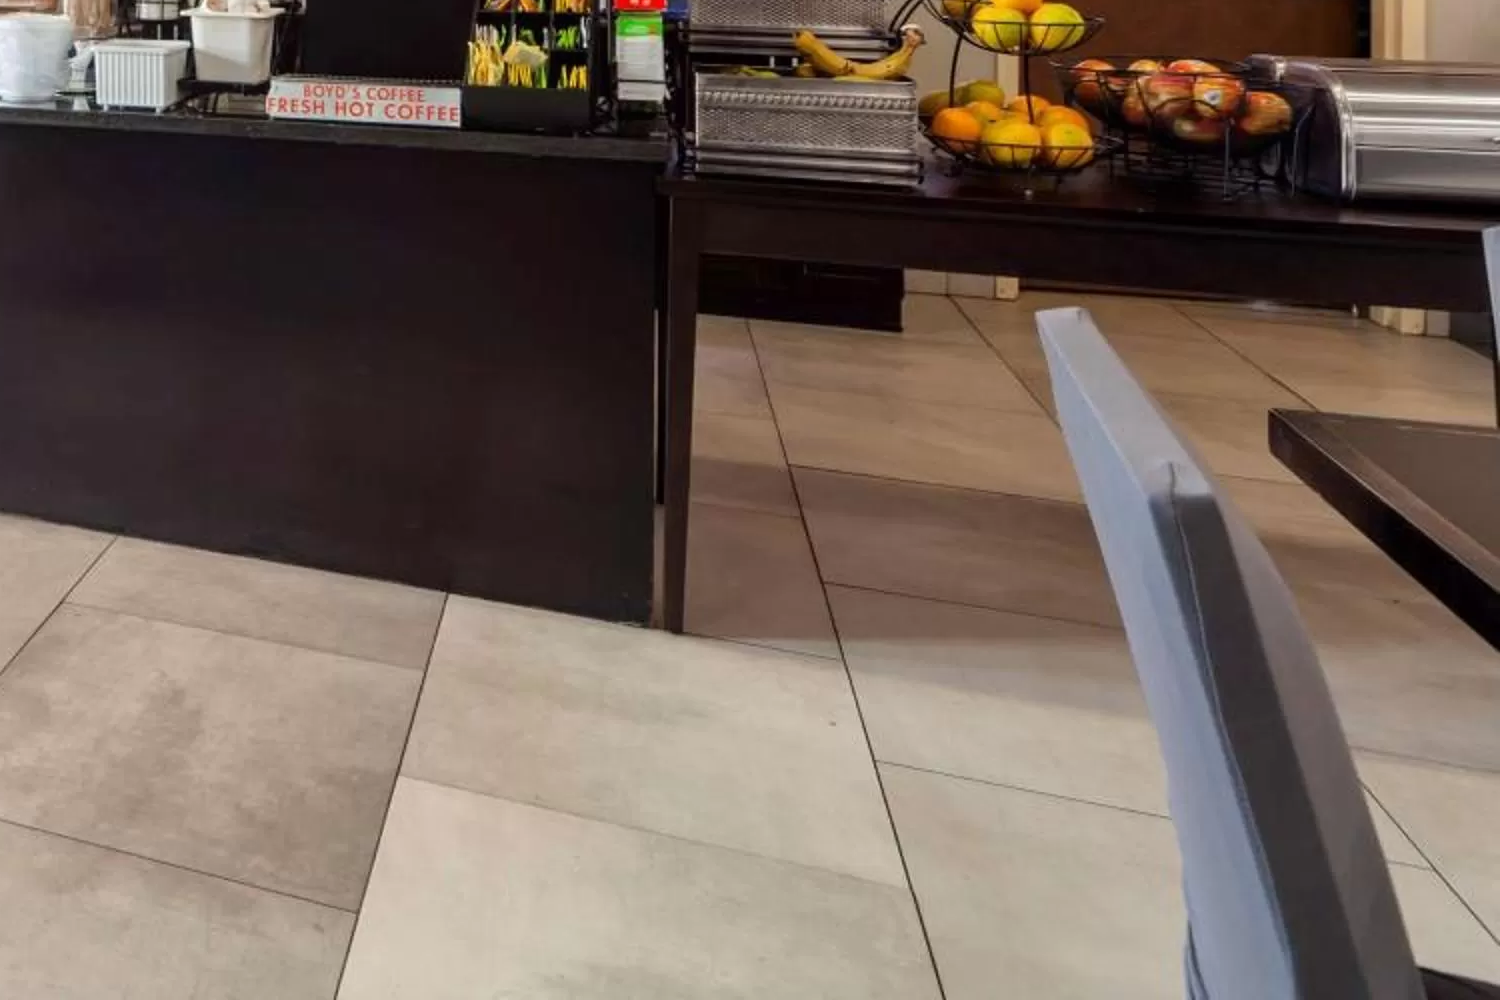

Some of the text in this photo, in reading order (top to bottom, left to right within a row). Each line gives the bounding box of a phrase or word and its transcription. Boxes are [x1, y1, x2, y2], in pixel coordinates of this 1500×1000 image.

[303, 83, 426, 103] BOYD'S COFFEE
[267, 97, 459, 122] FRESH HOT COFFEE
